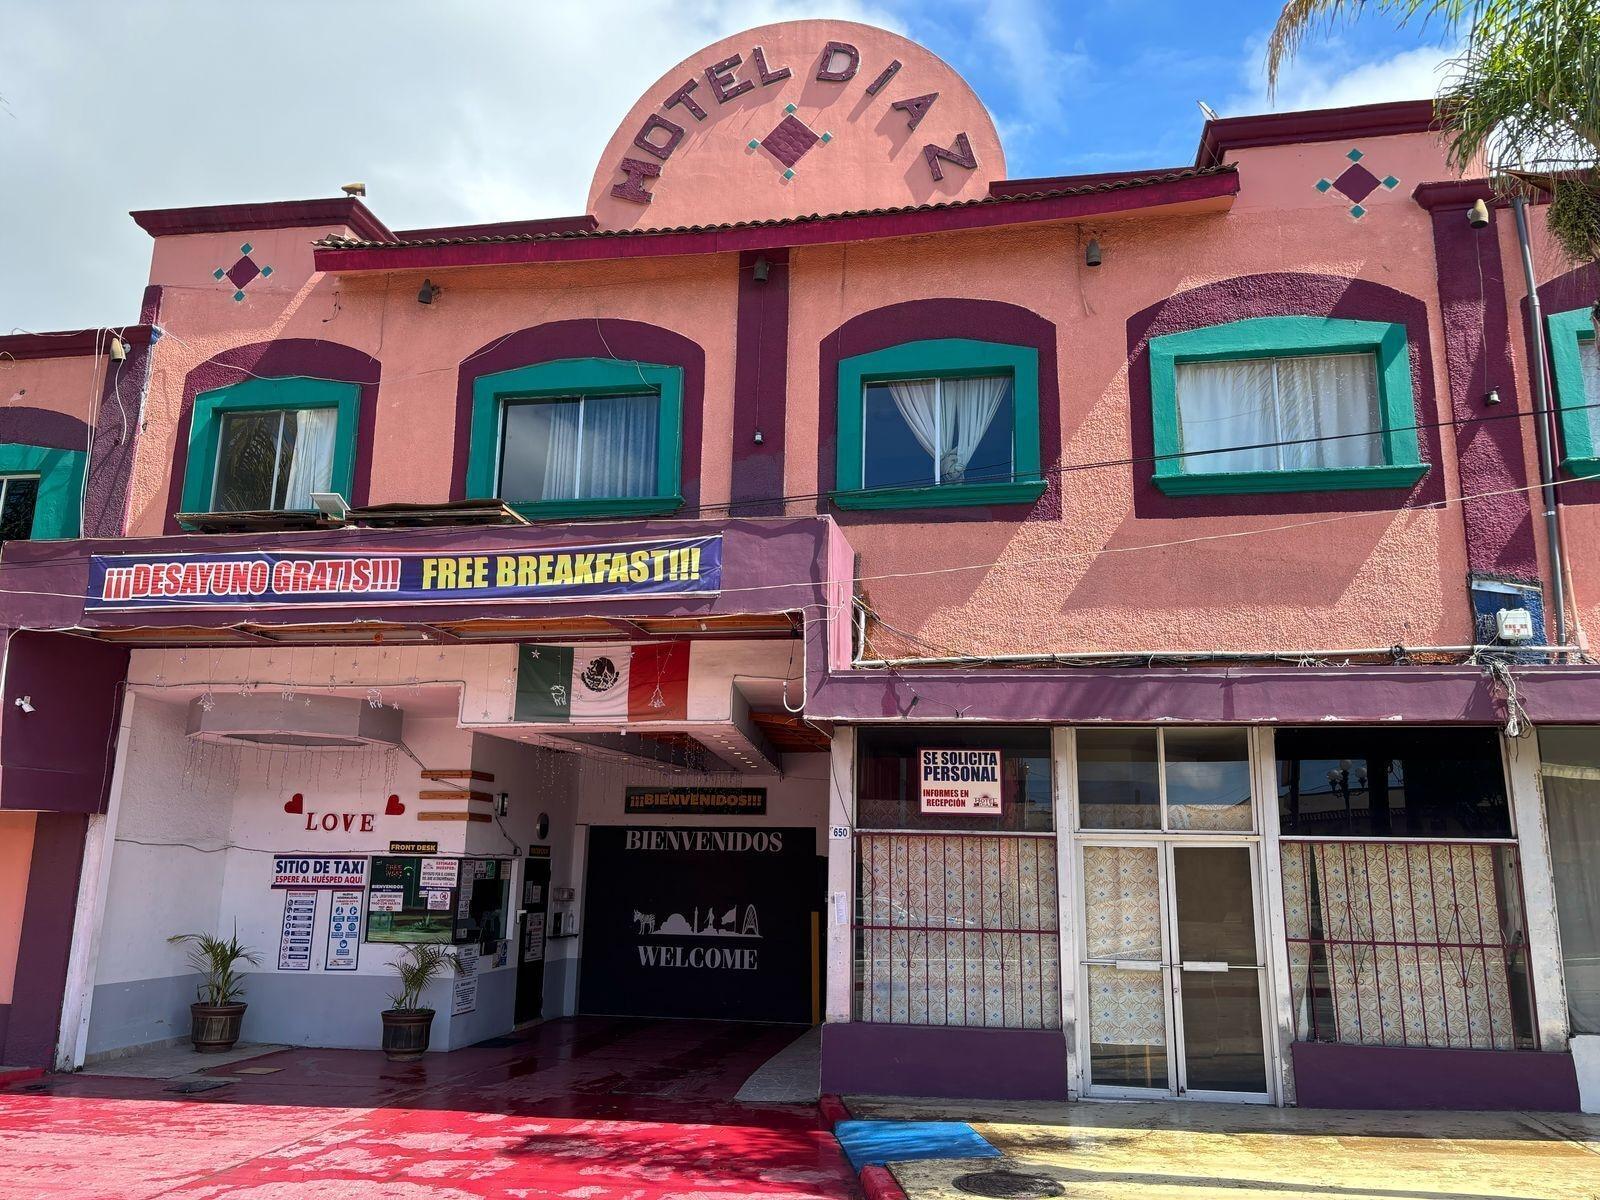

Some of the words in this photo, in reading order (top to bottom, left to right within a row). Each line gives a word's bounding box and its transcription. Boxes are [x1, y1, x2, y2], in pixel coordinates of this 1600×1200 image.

[816, 41, 979, 182] DIAN
[102, 560, 269, 601] ¡¡¡DESAYUNO
[271, 558, 401, 594] GRATIS!!!
[422, 556, 489, 590] FREE
[496, 547, 701, 588] BREAKFAST!!!
[923, 751, 938, 765] SE
[941, 751, 998, 765] SOLICITA
[923, 766, 998, 782] PERSONAL
[630, 792, 762, 807] ¡¡¡BIENVENIDOS!!!
[923, 789, 959, 798] INFORMES
[960, 789, 969, 798] EN
[926, 798, 966, 807] RECEPCIÓN
[305, 811, 375, 833] LOVE
[833, 828, 848, 837] 650
[625, 830, 783, 852] BIENVENIDOS
[275, 860, 310, 874] SITIO
[313, 860, 330, 874] DE
[334, 860, 365, 874] TAXI
[311, 874, 343, 884] HUÉSPED
[344, 875, 363, 884] AQUÍ
[637, 945, 758, 970] WELCOME
